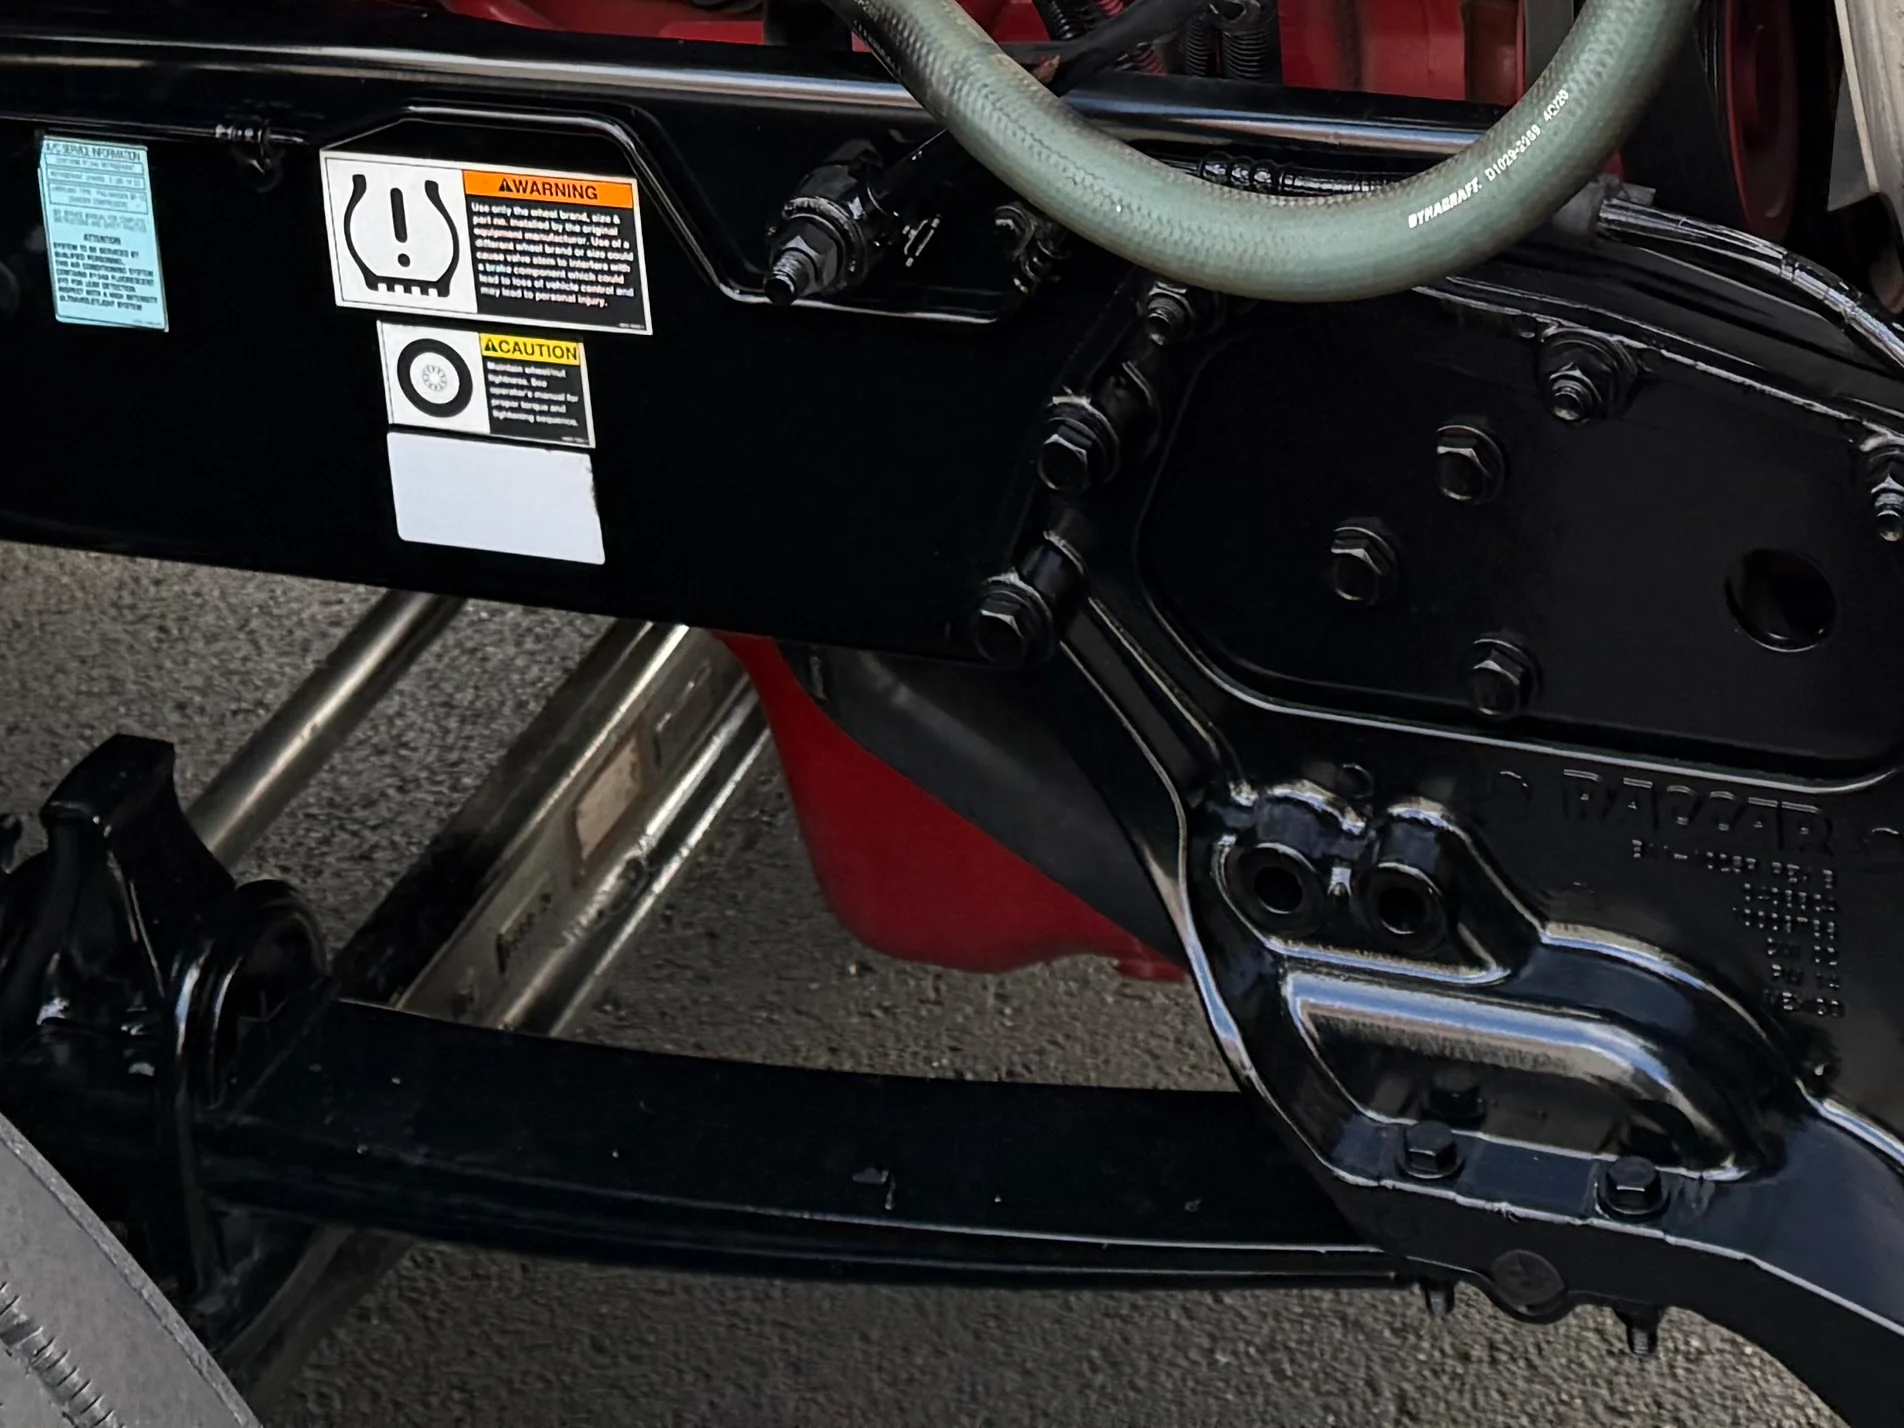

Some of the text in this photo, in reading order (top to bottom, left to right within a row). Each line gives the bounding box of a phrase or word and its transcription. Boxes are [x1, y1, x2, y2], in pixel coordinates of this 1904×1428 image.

[512, 179, 598, 200] WARNING
[498, 339, 577, 360] CAUTION
[1563, 768, 1835, 857] PACCAR
